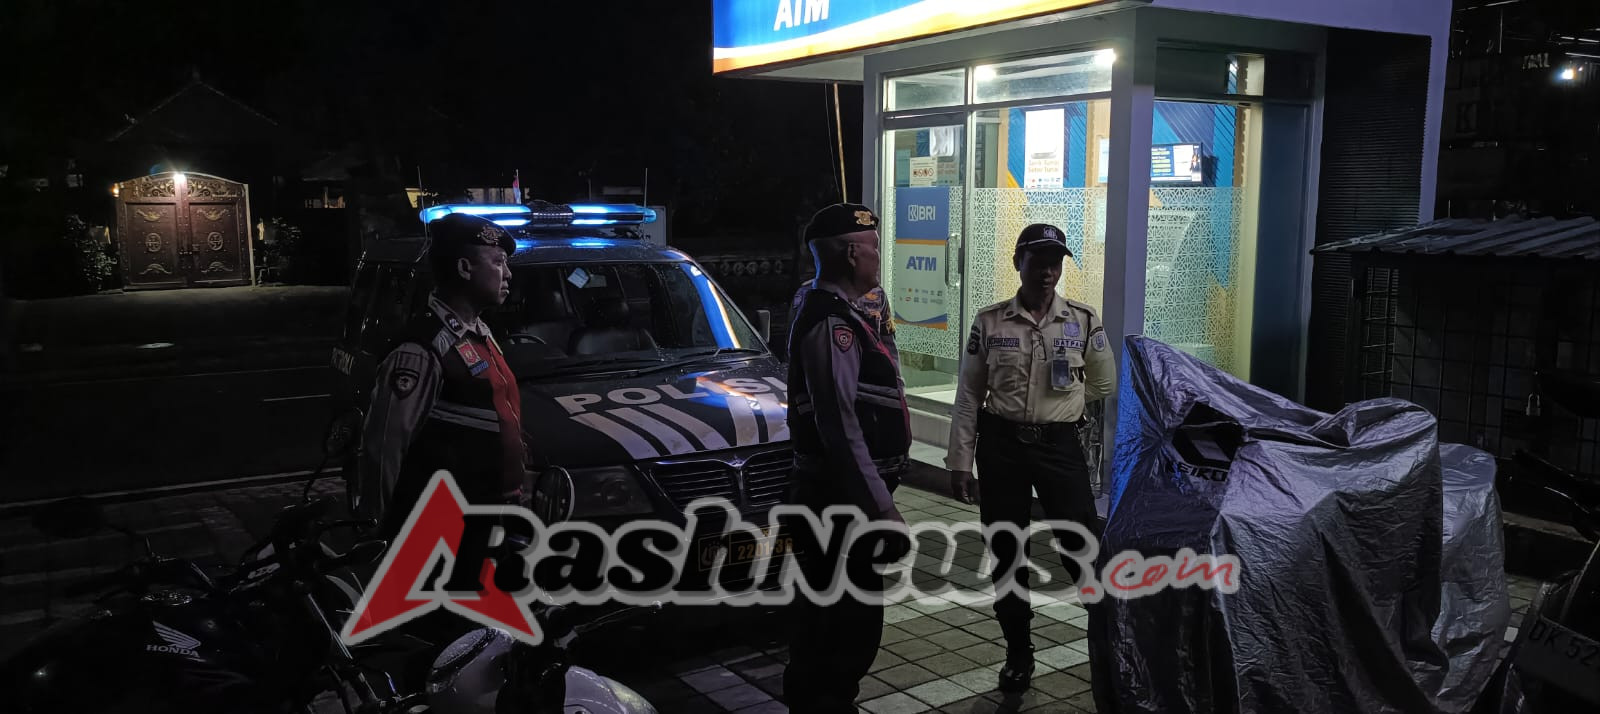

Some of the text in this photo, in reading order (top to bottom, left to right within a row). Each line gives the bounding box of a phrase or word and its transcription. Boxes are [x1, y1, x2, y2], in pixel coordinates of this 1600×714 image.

[773, 0, 830, 31] ATM
[919, 205, 936, 221] BRI
[906, 256, 937, 271] ATM
[554, 376, 788, 414] POLISI
[145, 644, 201, 658] HONDA
